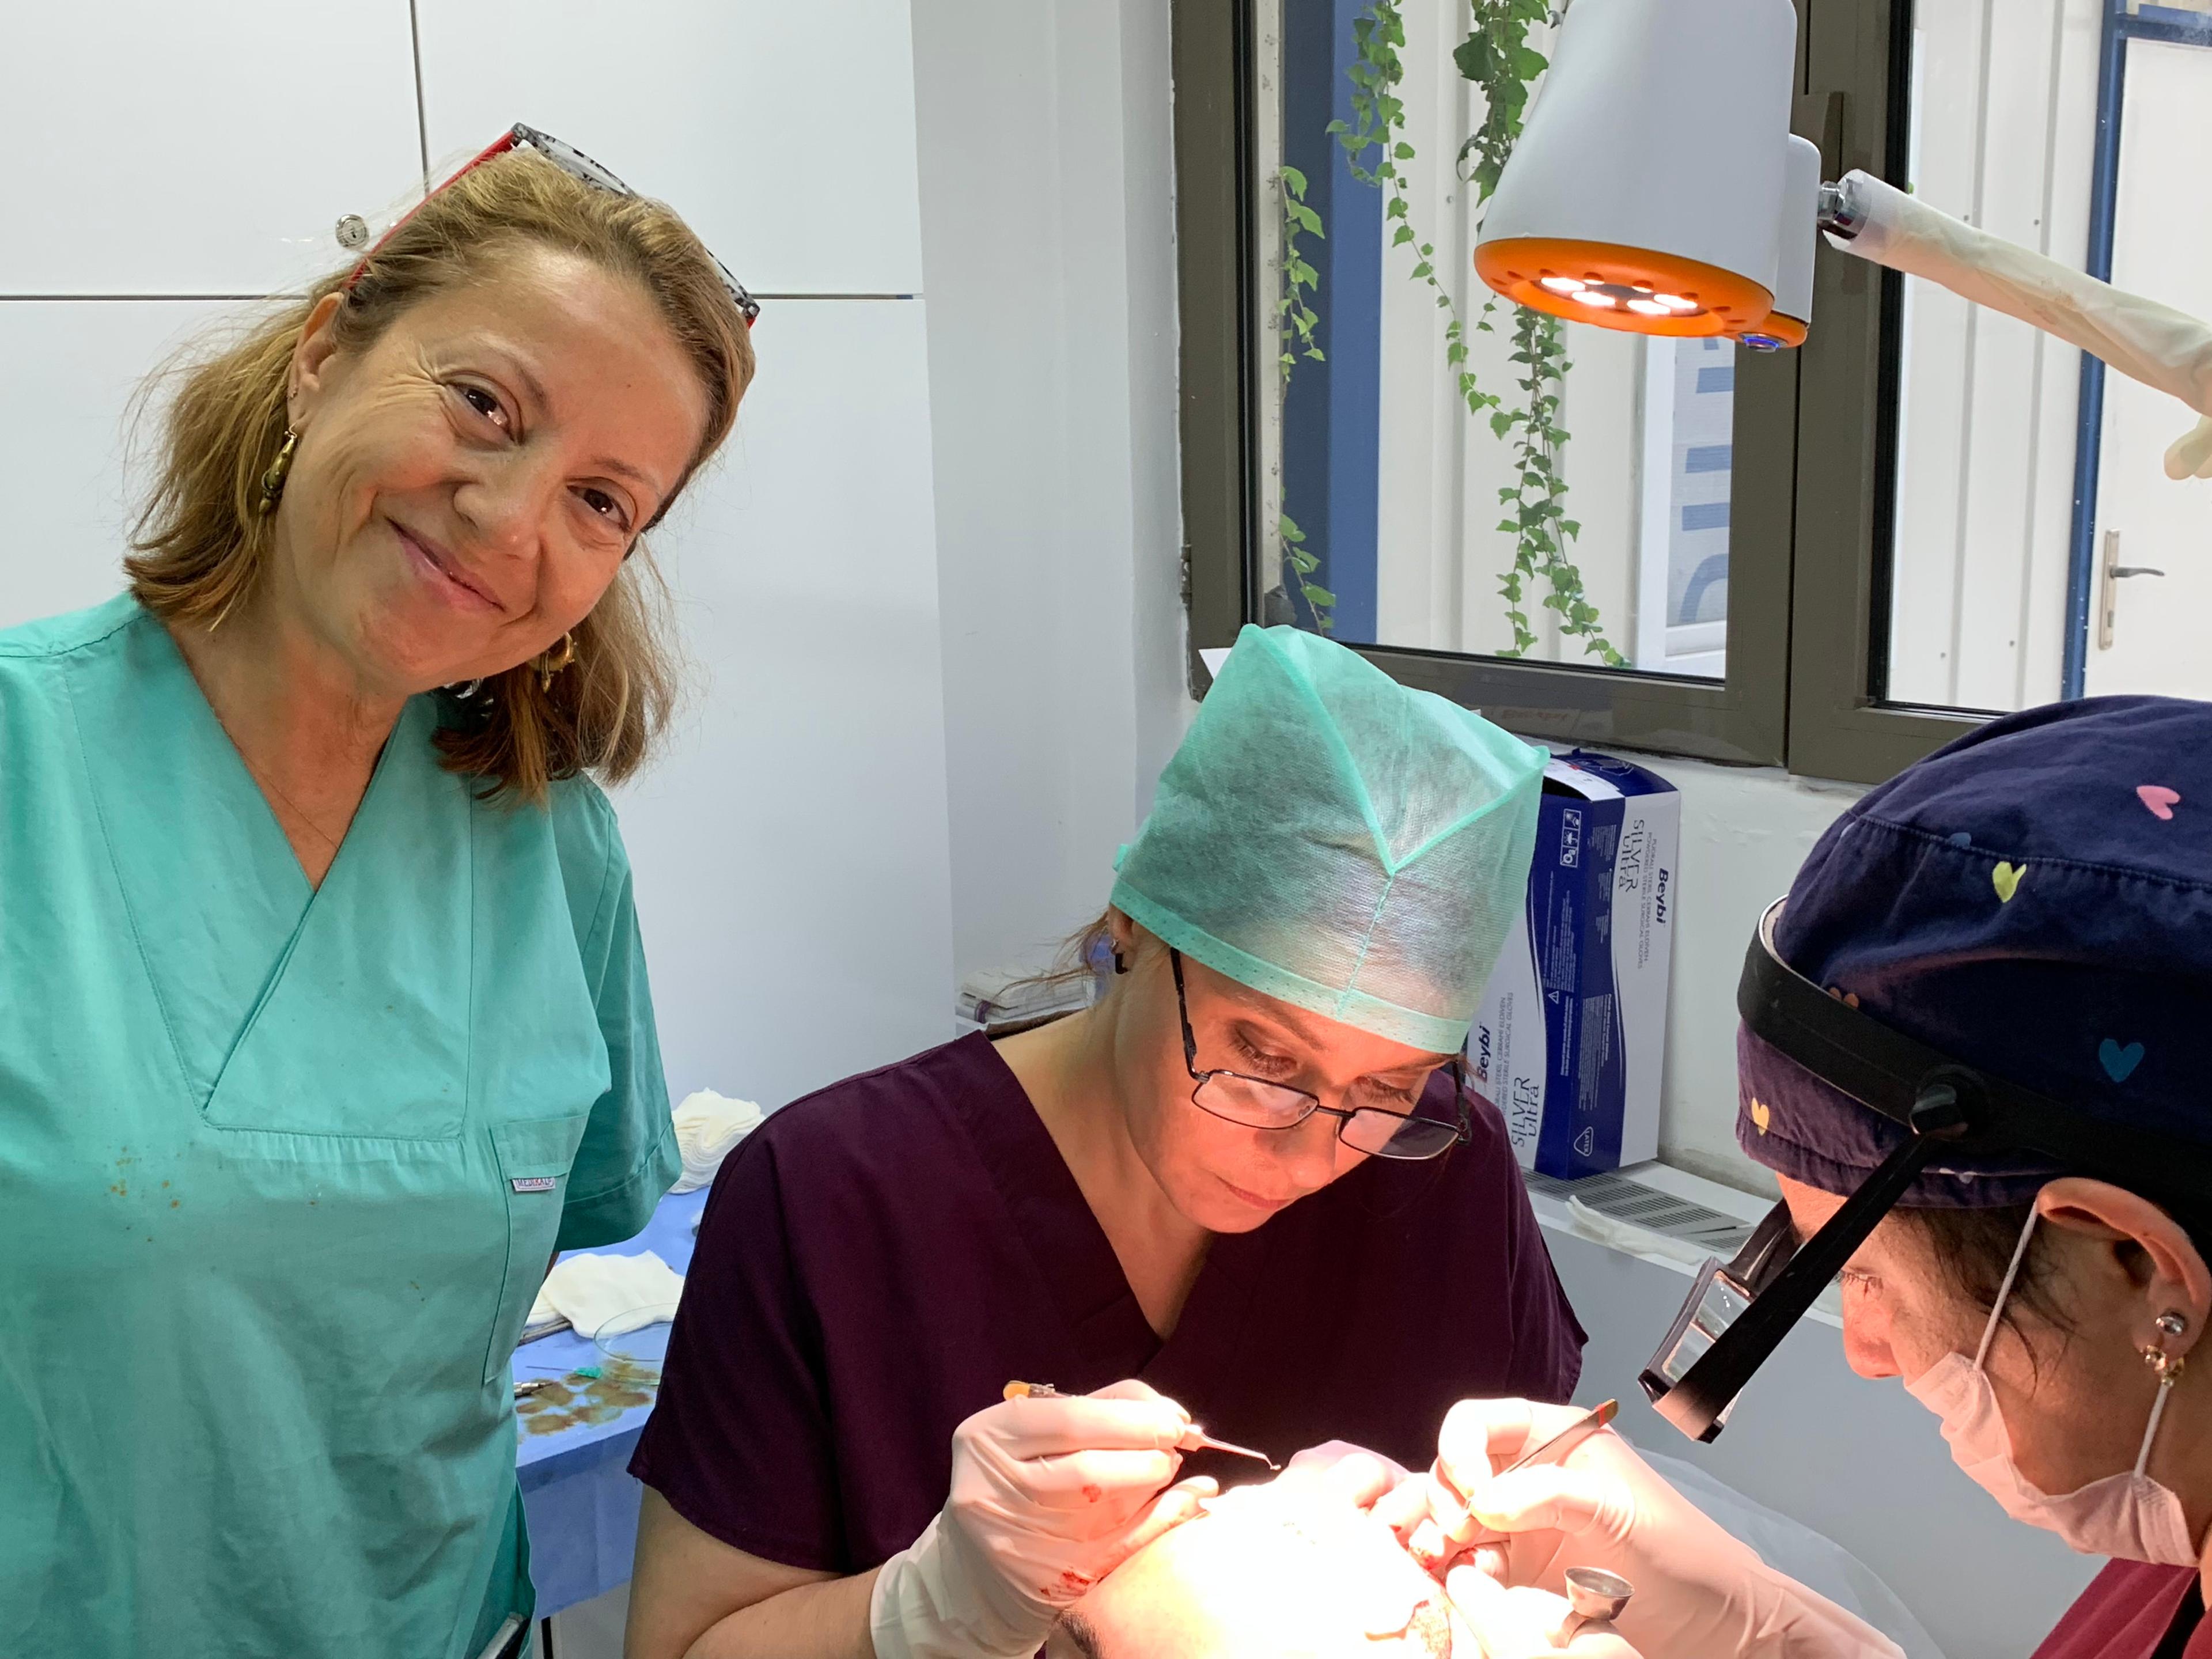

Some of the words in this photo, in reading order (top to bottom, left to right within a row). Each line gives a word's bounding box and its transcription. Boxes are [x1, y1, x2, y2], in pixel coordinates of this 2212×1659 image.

[1626, 819, 1645, 892] SILVER
[1656, 868, 1668, 924] Beybi
[1476, 1025, 1491, 1083] Beybi
[1511, 1077, 1530, 1147] SILVER
